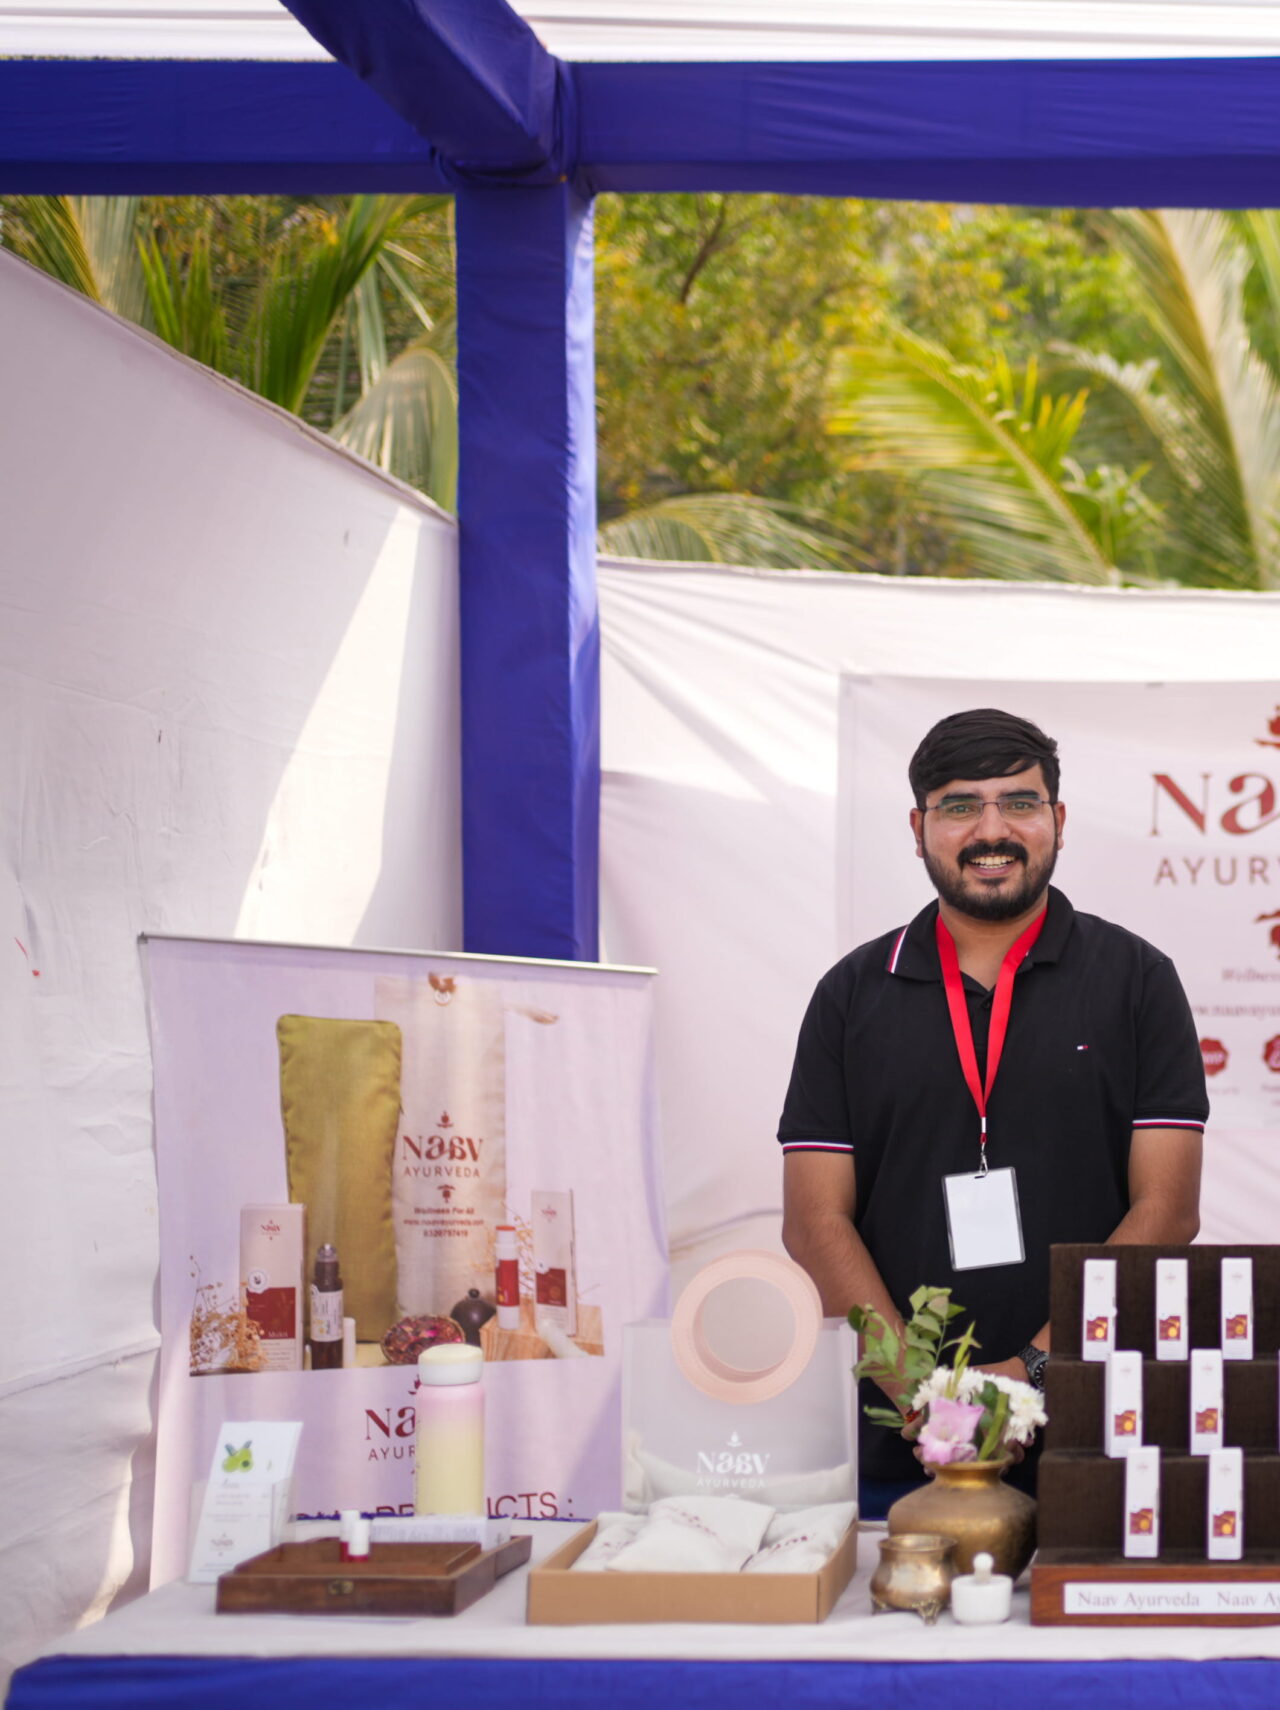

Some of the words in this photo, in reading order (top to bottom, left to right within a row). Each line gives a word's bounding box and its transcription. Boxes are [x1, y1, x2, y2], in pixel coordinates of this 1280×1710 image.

[404, 1166, 480, 1178] AYURVEDA
[365, 1406, 416, 1440] Na
[368, 1445, 416, 1461] AYUR
[696, 1477, 766, 1489] AYURVEDA
[1078, 1591, 1118, 1607] Naav
[1123, 1591, 1200, 1610] Ayurveda
[1217, 1591, 1258, 1607] Naav
